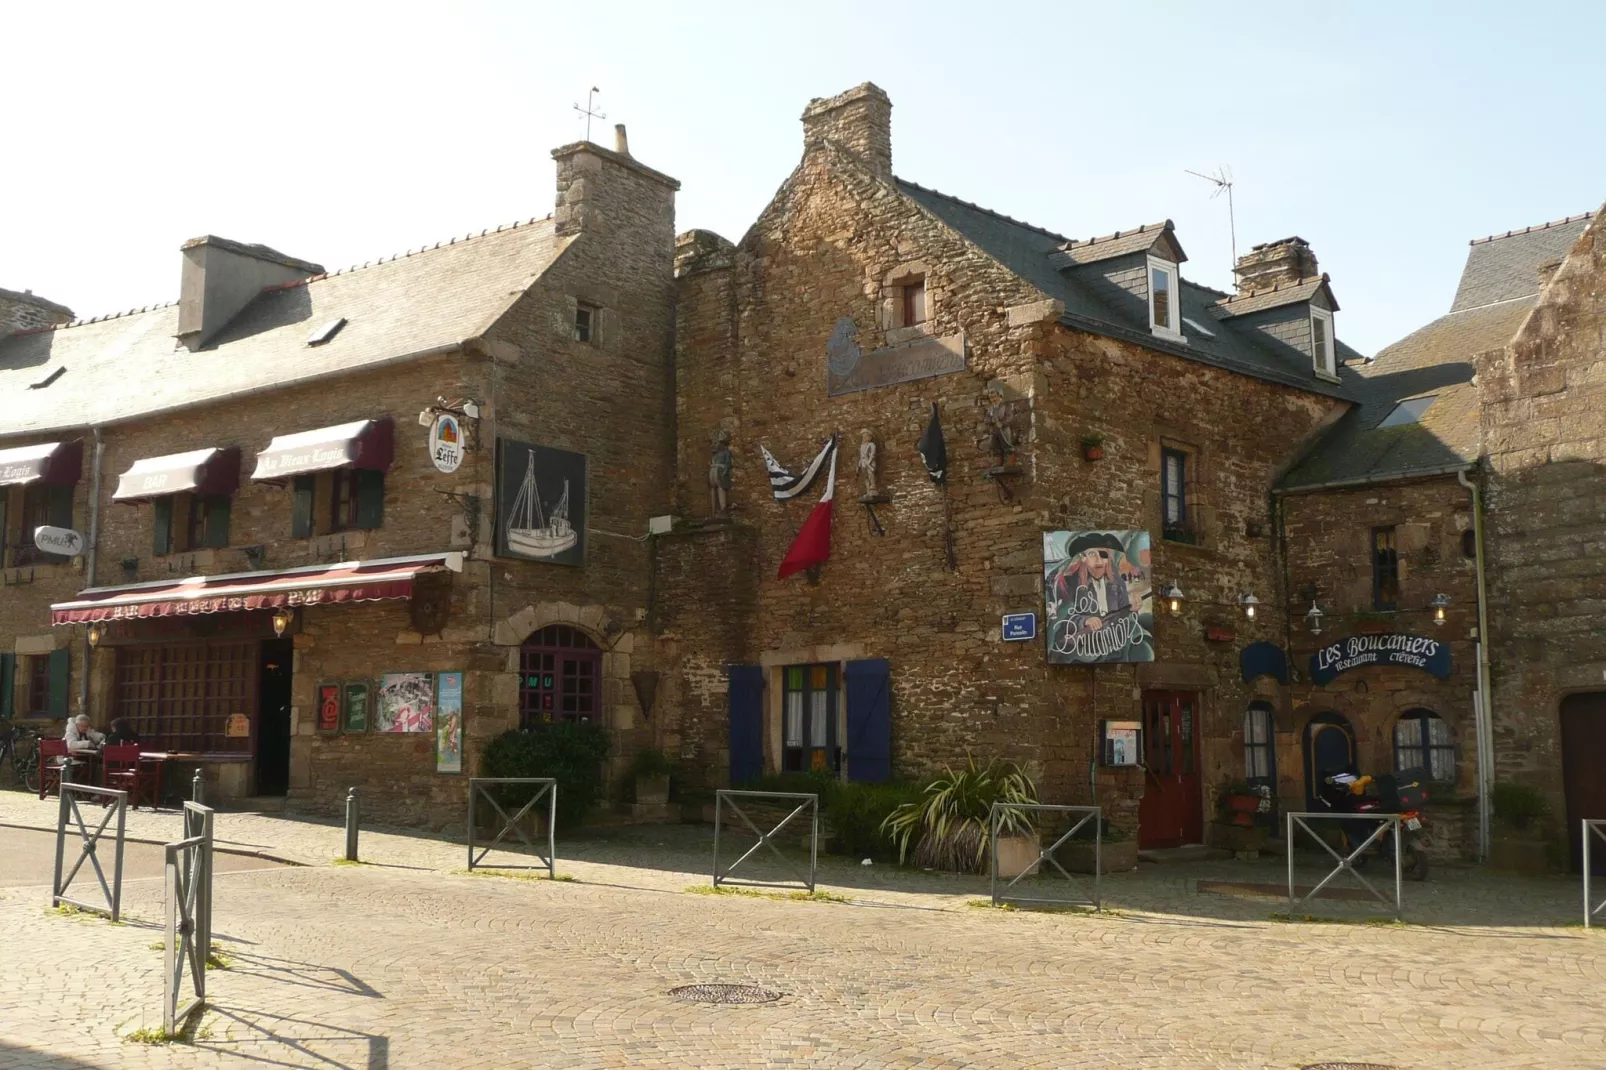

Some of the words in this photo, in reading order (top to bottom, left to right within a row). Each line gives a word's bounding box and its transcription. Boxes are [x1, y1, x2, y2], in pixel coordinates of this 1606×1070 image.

[435, 447, 458, 465] Leffe
[143, 474, 168, 489] BAR
[41, 534, 65, 546] PMU
[288, 589, 322, 604] PMU
[1067, 584, 1099, 615] Les
[114, 605, 139, 618] BAR
[1318, 643, 1341, 671] Les
[1347, 633, 1440, 657] Boucaniers
[1335, 651, 1378, 672] restaurant
